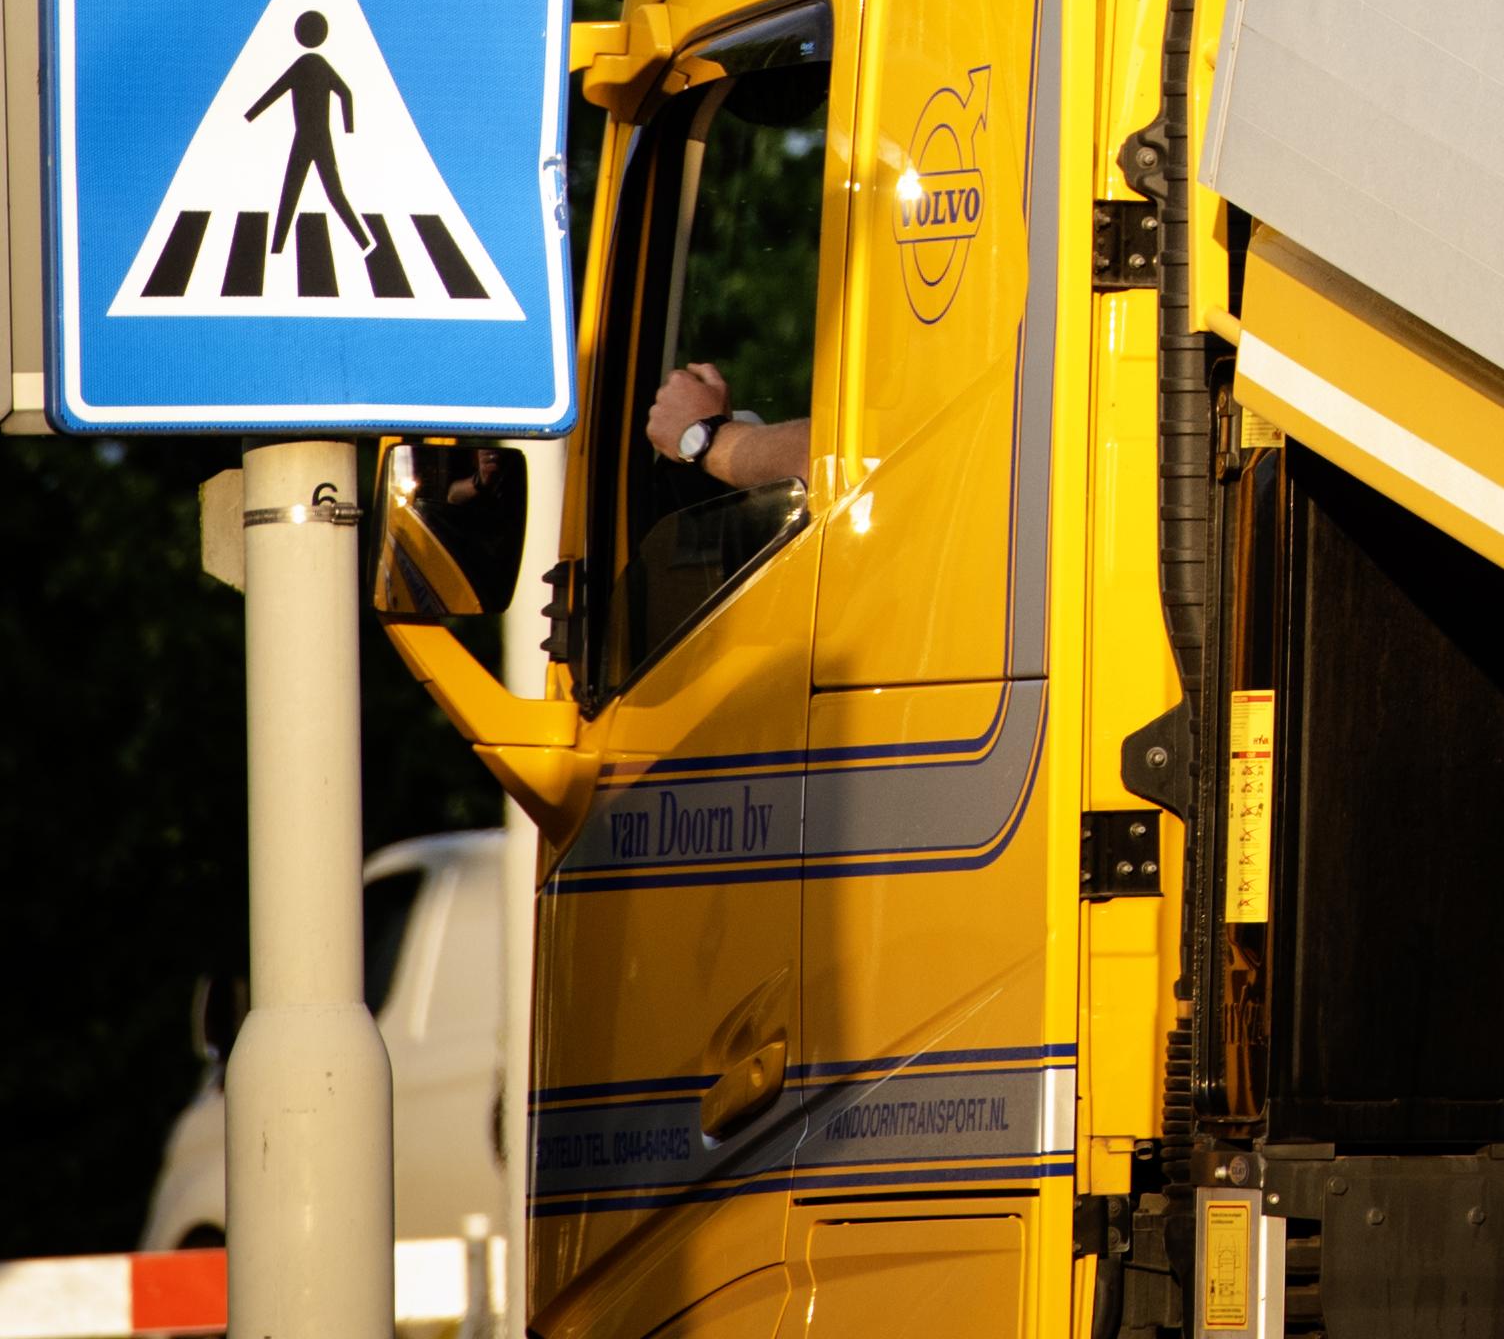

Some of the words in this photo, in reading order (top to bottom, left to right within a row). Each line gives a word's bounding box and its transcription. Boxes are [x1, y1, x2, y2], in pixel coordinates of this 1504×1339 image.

[902, 187, 980, 227] VOLVO
[610, 811, 649, 859] van
[656, 790, 733, 857] Doorn
[742, 785, 773, 851] bv
[825, 1096, 1010, 1141] VANDOORNTRANSPORT.NL
[613, 1126, 690, 1165] 0344-646425
